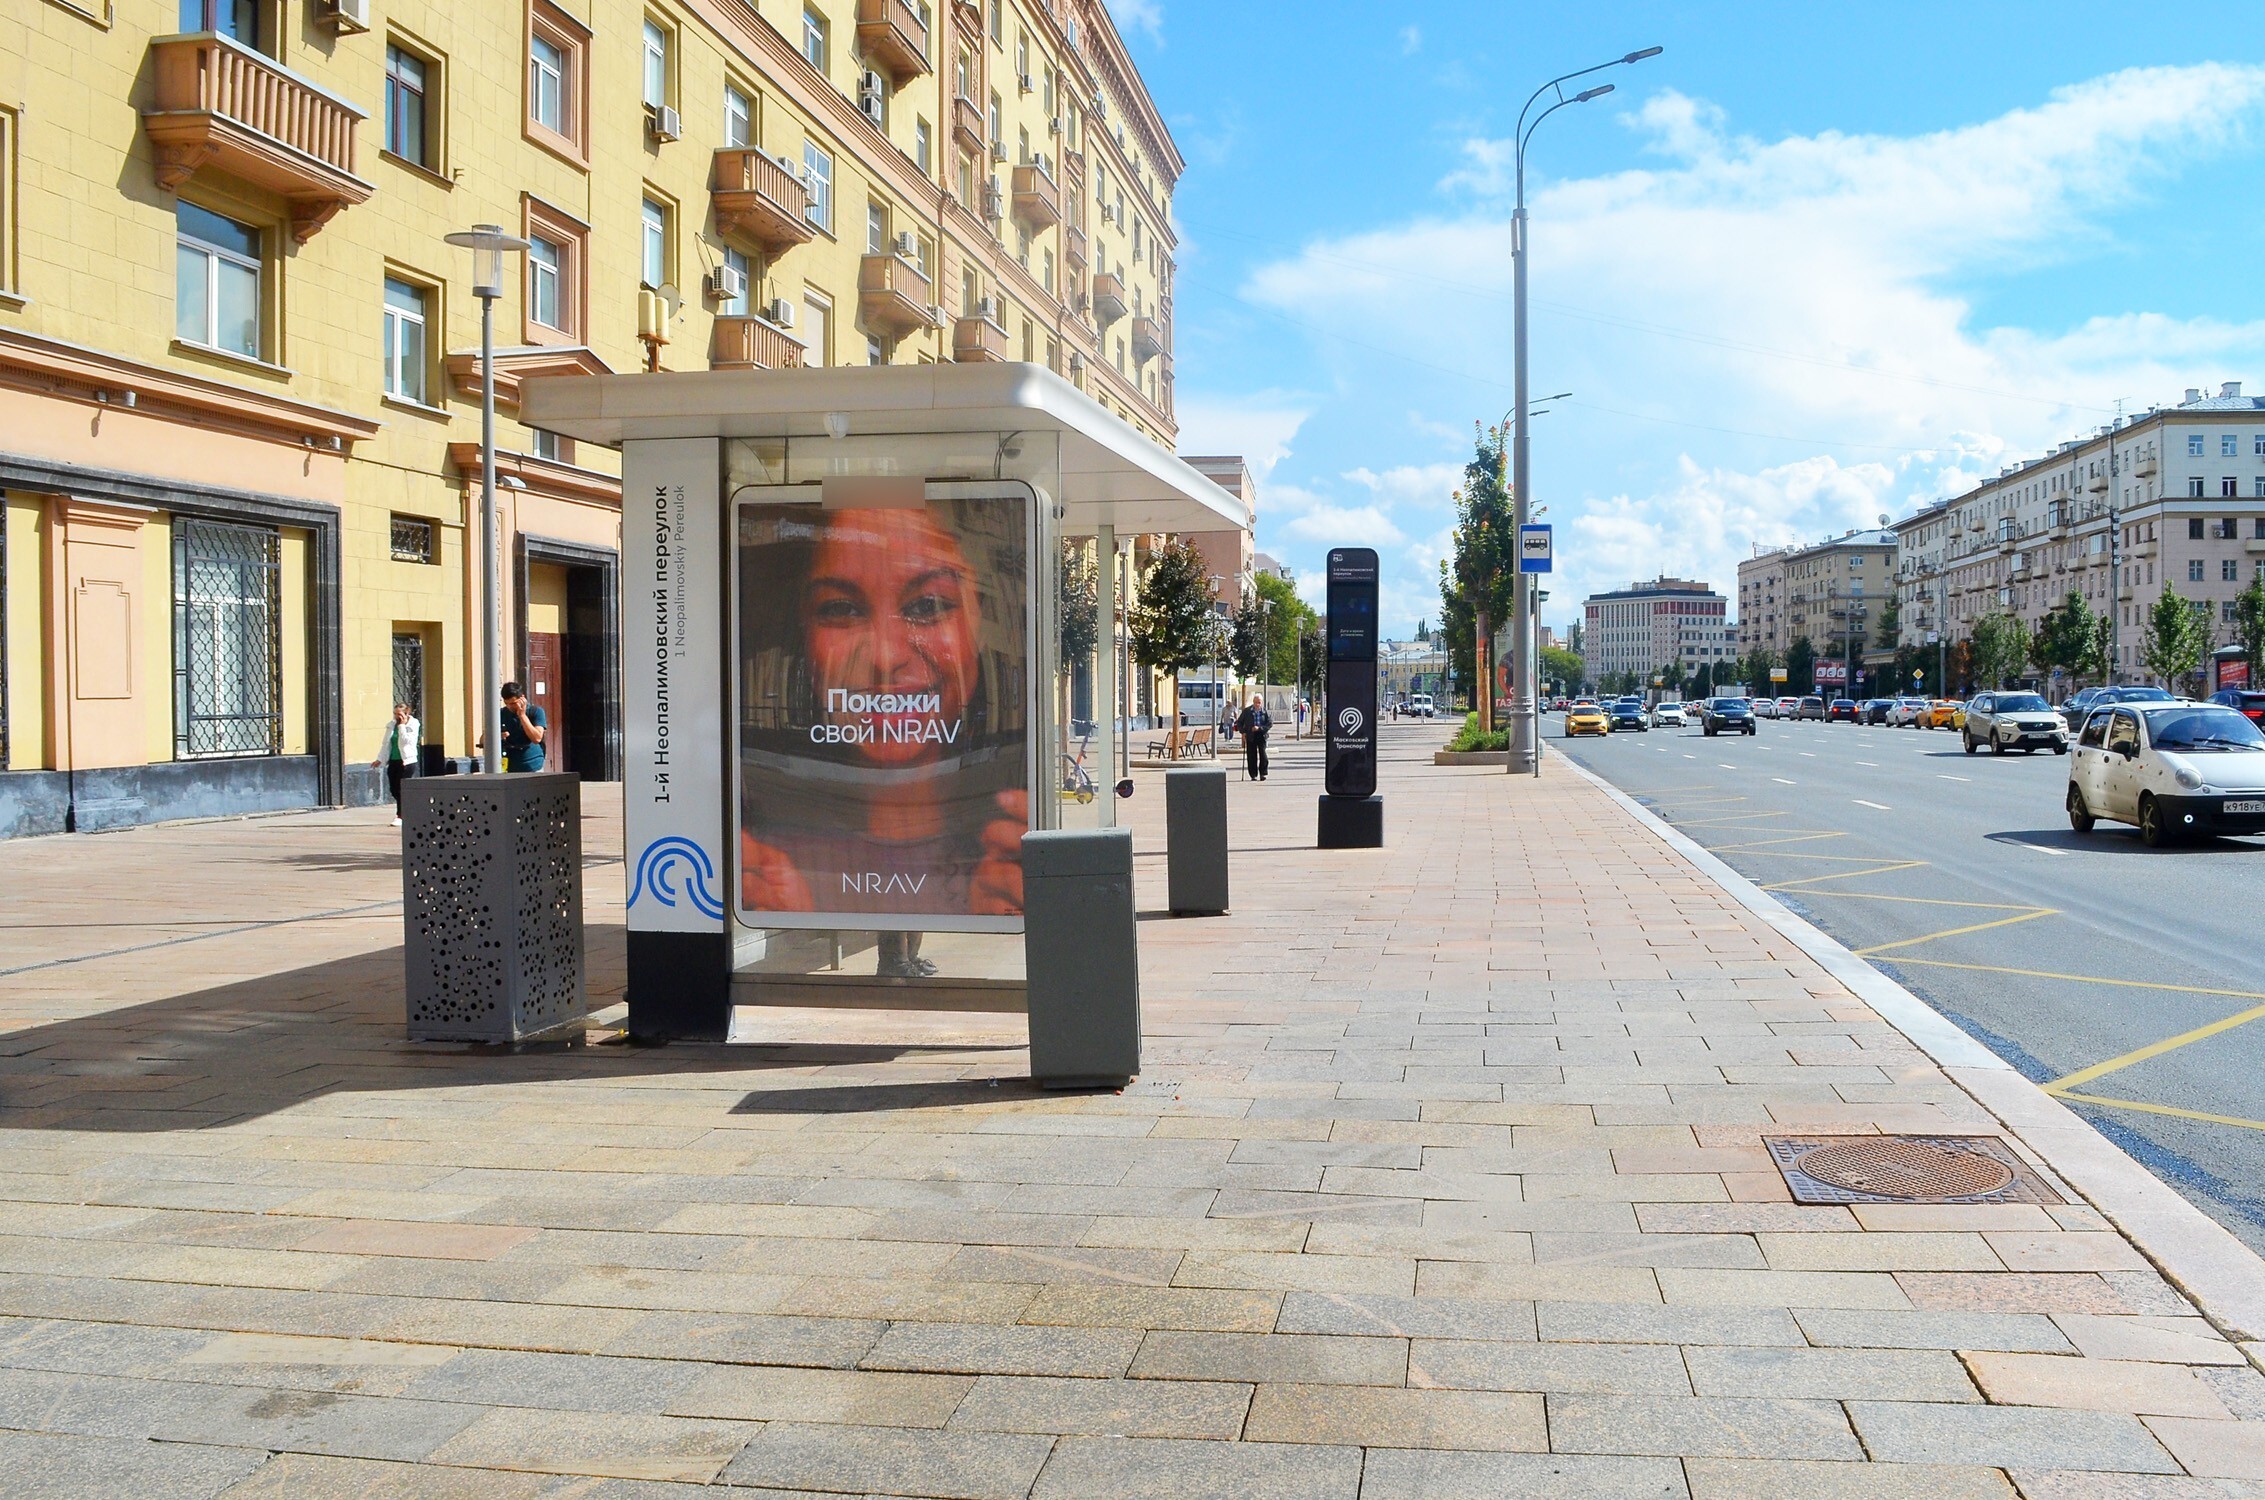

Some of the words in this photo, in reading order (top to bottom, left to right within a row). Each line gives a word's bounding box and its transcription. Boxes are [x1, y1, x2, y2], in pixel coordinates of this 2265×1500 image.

[673, 485, 685, 541] Pereulok
[655, 485, 671, 582] переулок
[674, 545, 688, 647] Neopalimovskiy
[652, 589, 669, 766] Неопалимовский
[827, 688, 940, 714] Покажи
[1495, 698, 1512, 707] ГАЗ
[809, 717, 876, 744] свой
[882, 719, 961, 744] NRAV
[654, 773, 670, 803] 1-й
[841, 872, 928, 895] NRAV
